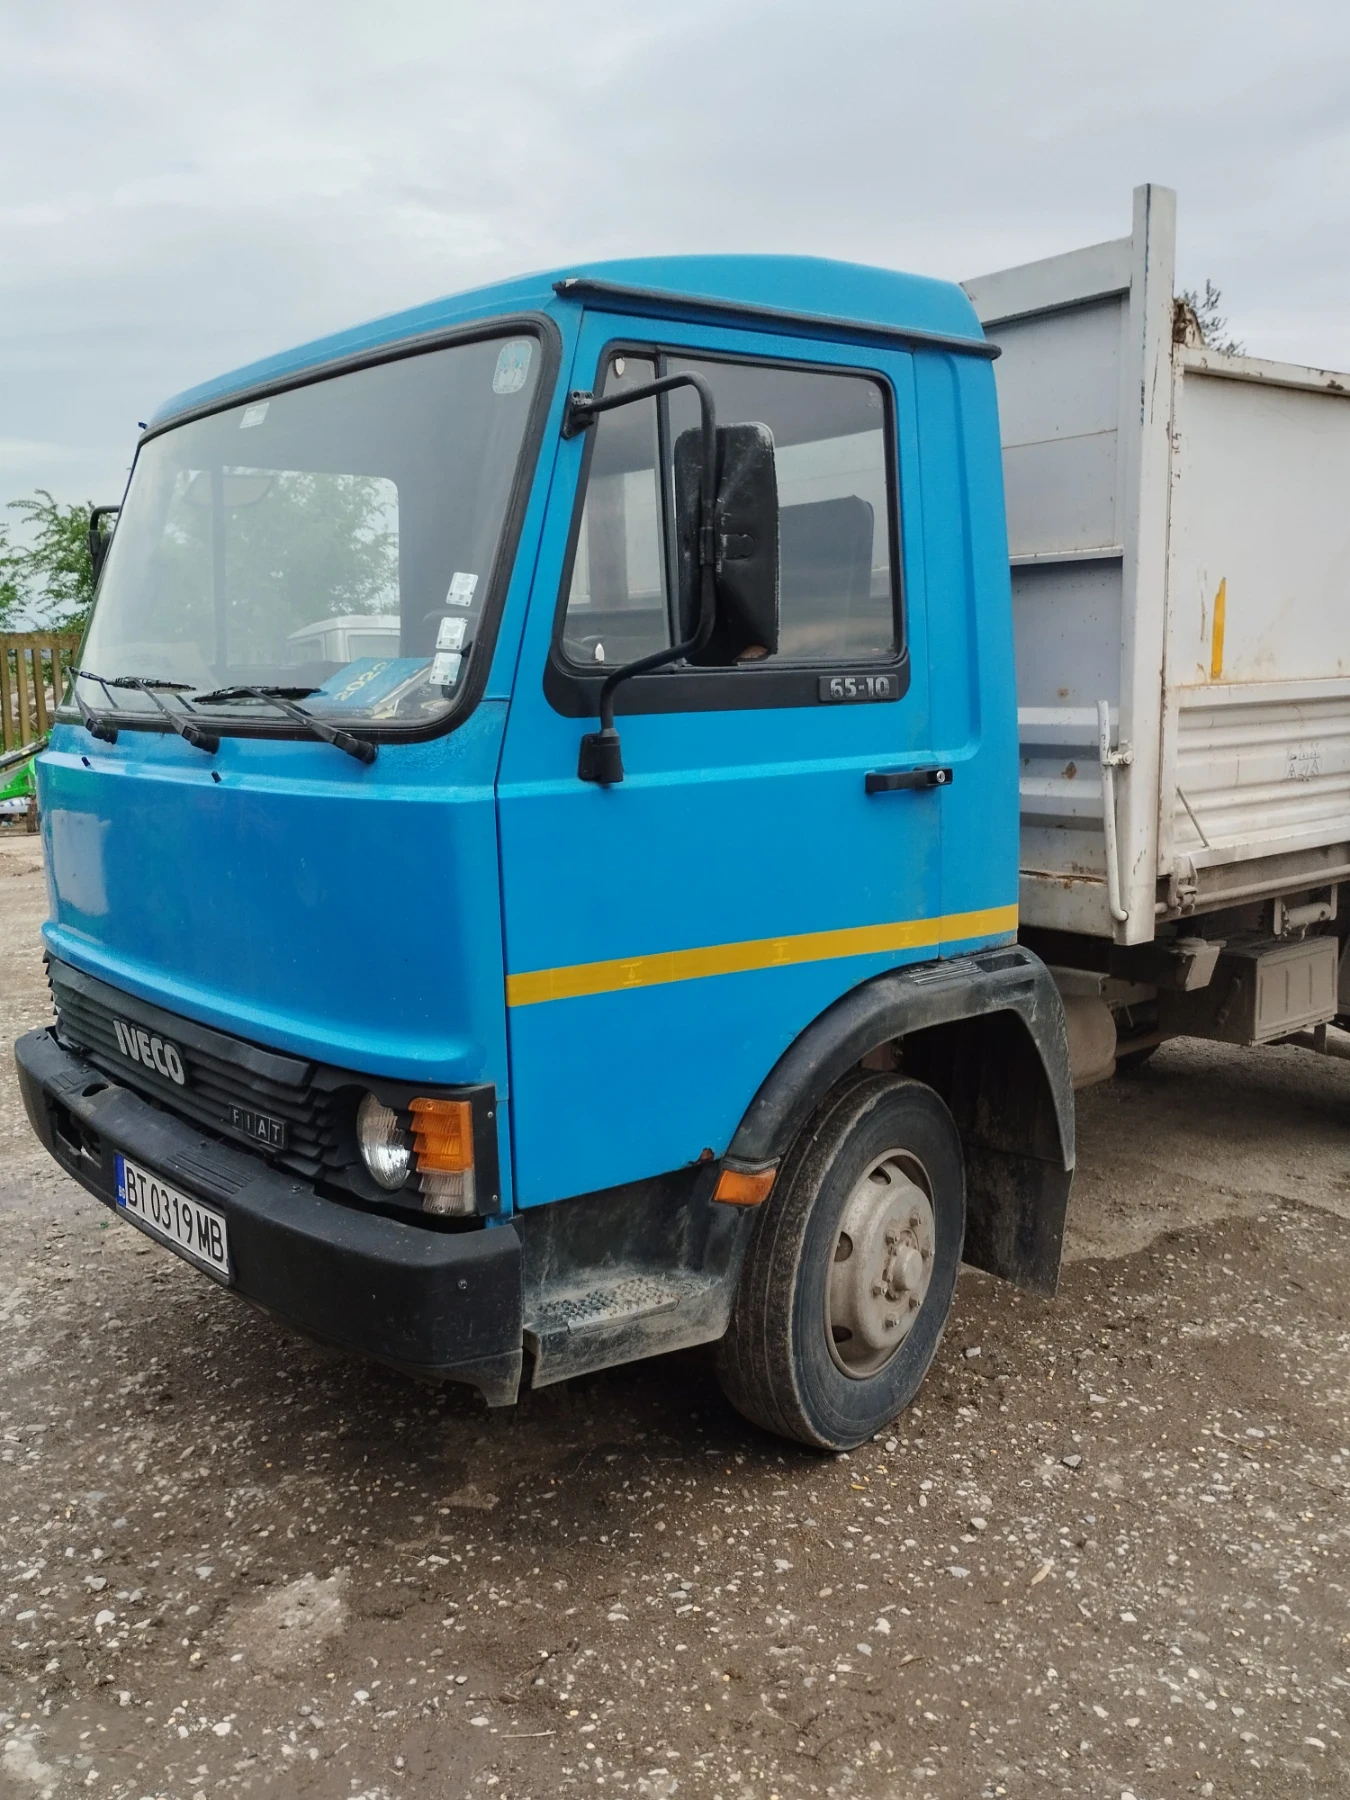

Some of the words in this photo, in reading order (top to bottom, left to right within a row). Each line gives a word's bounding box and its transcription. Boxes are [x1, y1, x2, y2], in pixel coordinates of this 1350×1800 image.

[830, 677, 889, 698] 65-10
[113, 1019, 185, 1085] IVECO
[233, 1109, 280, 1142] FIAT
[126, 1166, 147, 1214] BT
[151, 1183, 193, 1244] 0319
[196, 1210, 224, 1262] MB
